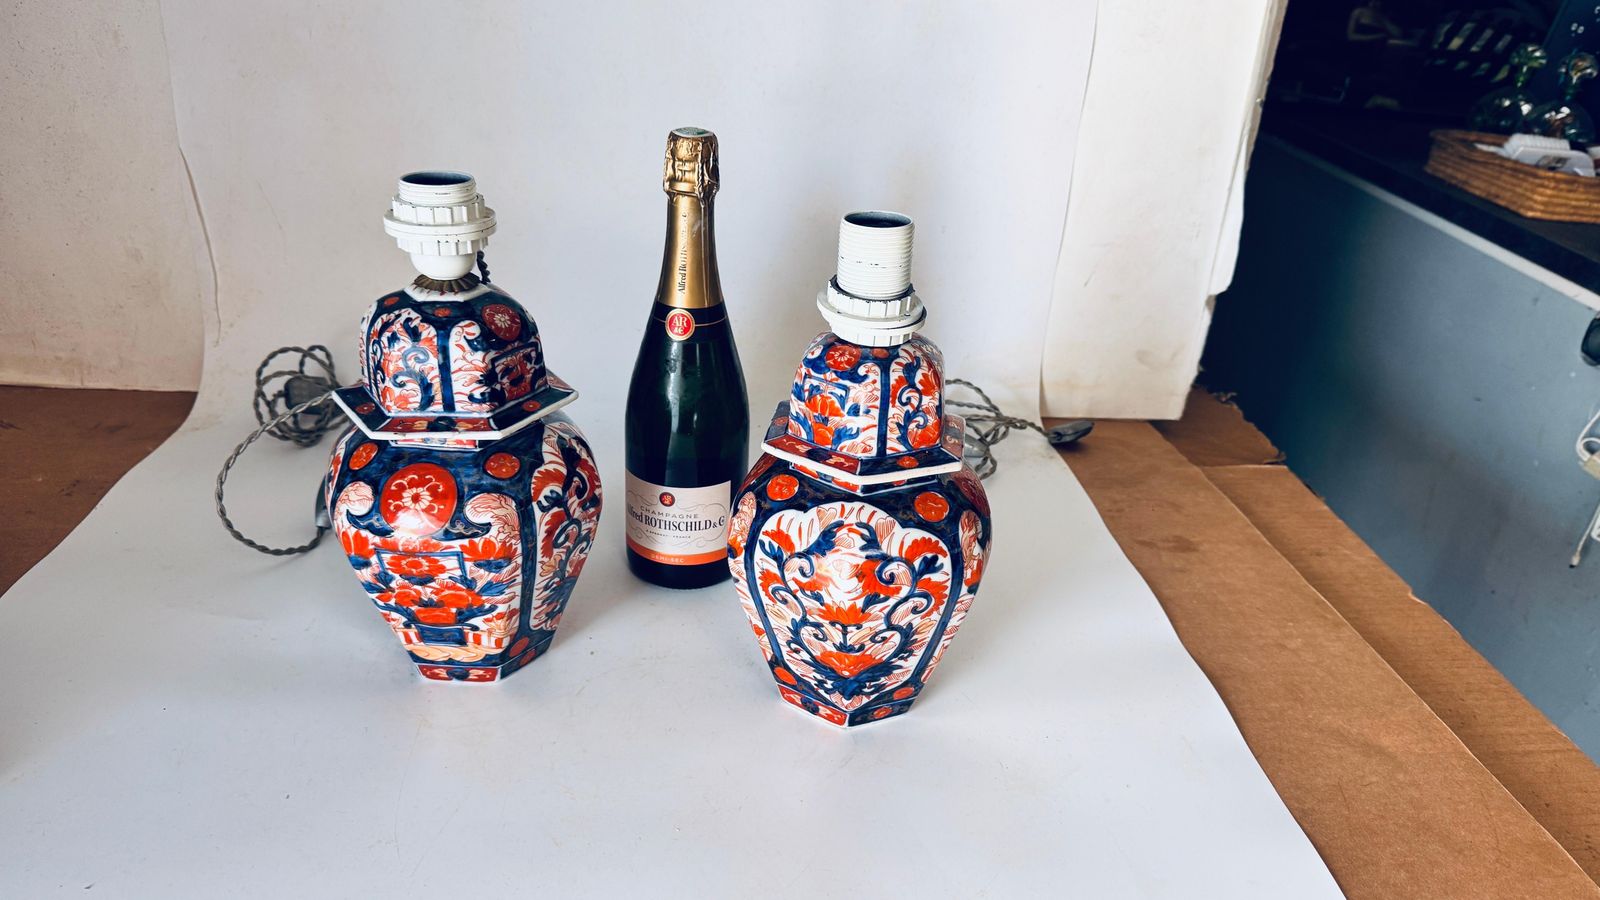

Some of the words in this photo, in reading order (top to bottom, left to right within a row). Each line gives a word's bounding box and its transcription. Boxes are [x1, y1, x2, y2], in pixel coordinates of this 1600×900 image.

[677, 272, 686, 294] Alfred
[672, 315, 688, 328] AR
[640, 506, 699, 519] CHAMPAGNE
[645, 514, 712, 532] ROTHSCHILD
